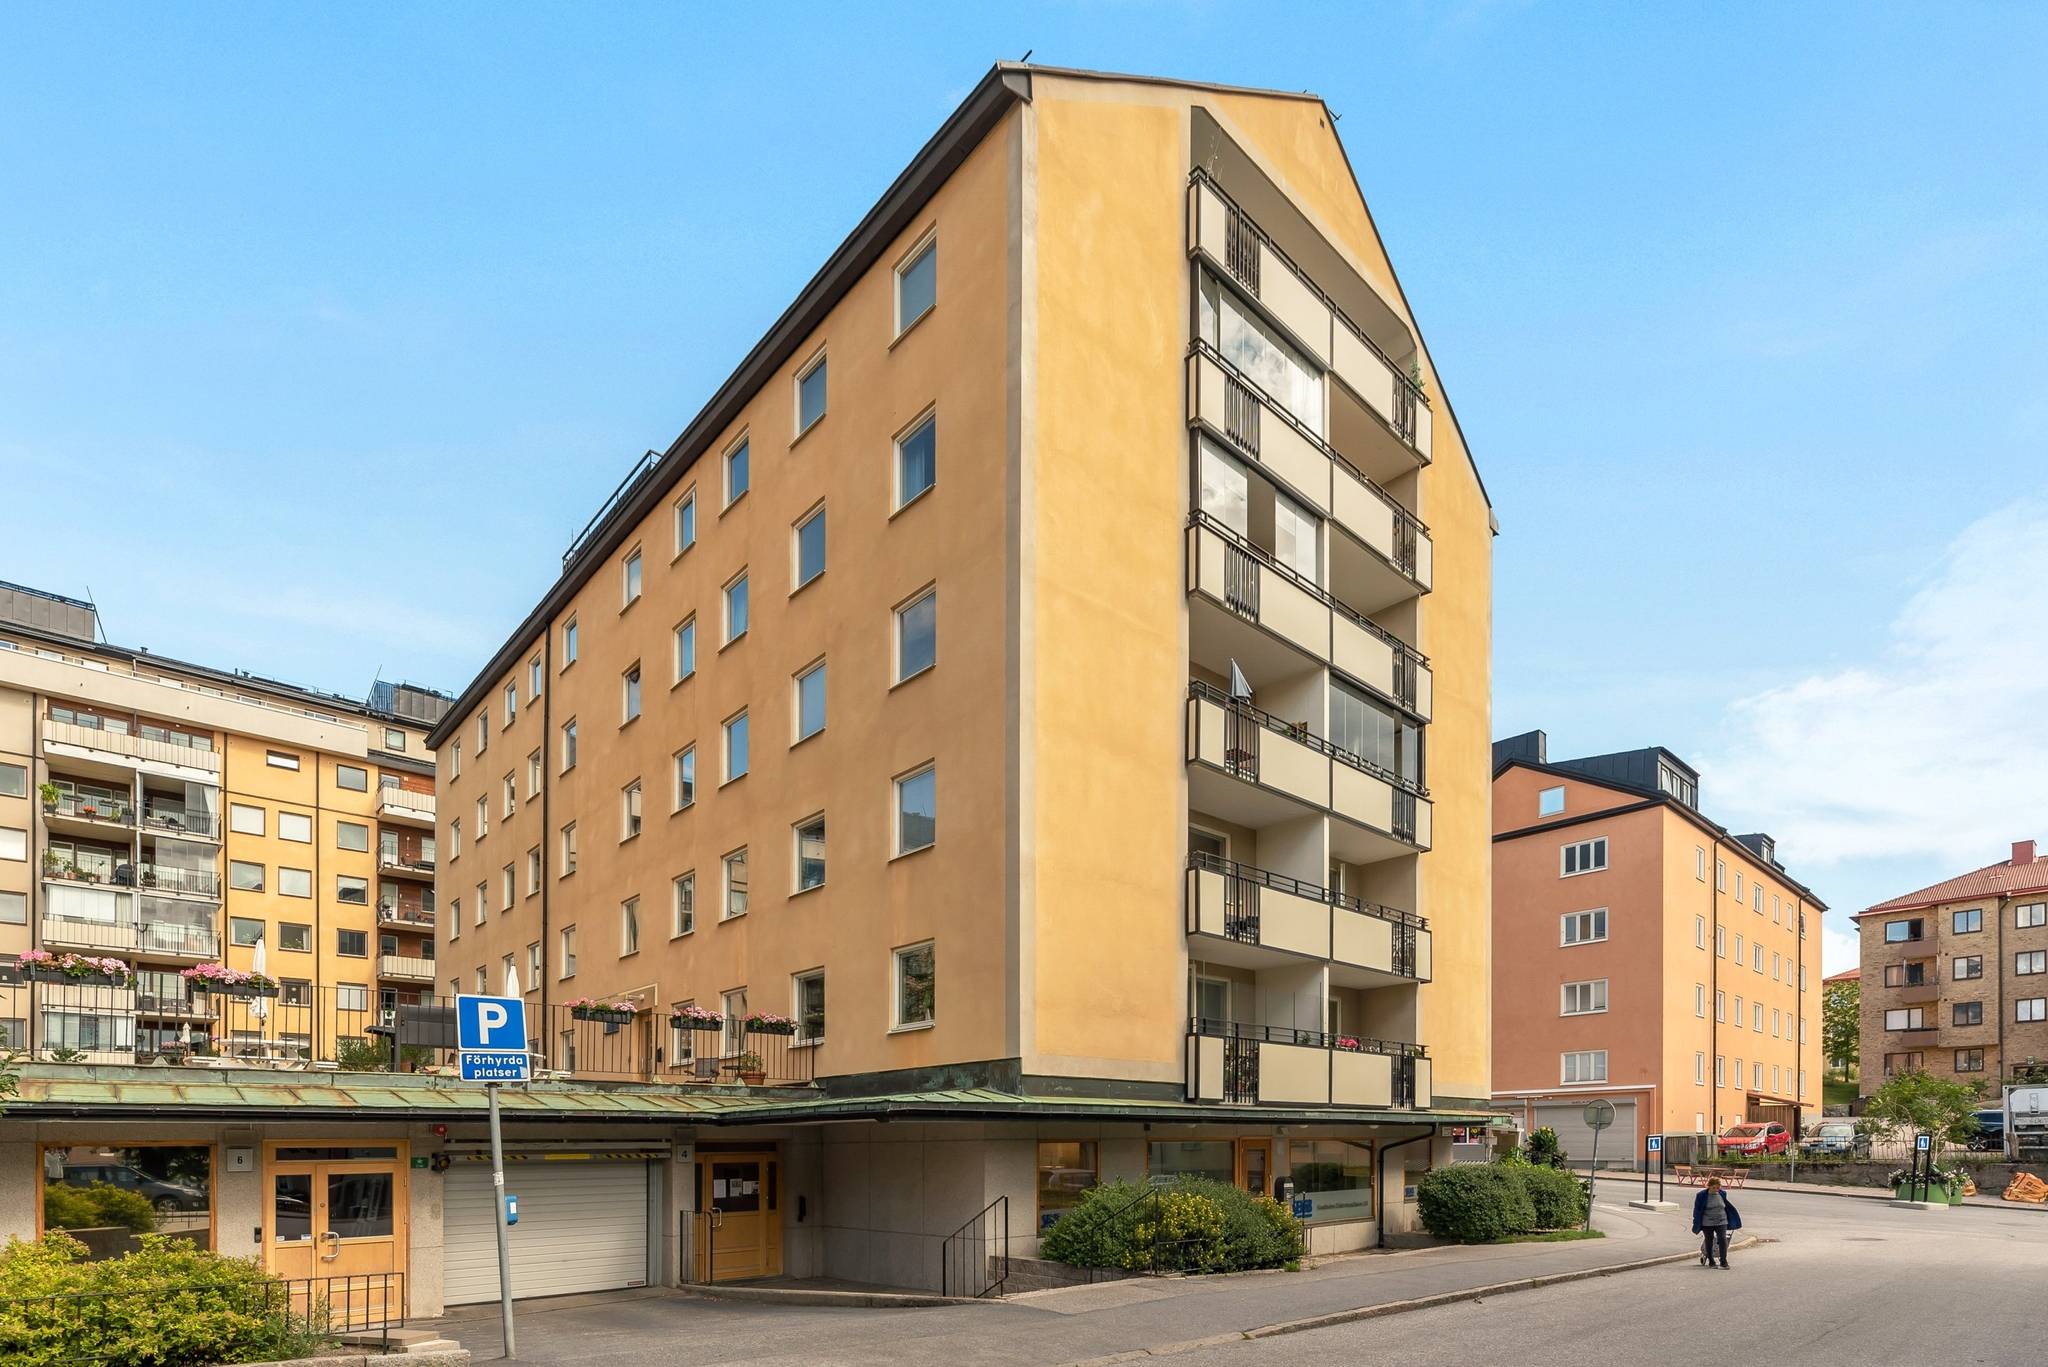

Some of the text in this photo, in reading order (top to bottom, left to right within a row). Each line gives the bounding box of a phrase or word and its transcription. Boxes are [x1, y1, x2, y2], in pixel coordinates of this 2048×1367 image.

[477, 1002, 508, 1045] P
[466, 1054, 523, 1066] Förhyrda
[474, 1067, 518, 1079] platser
